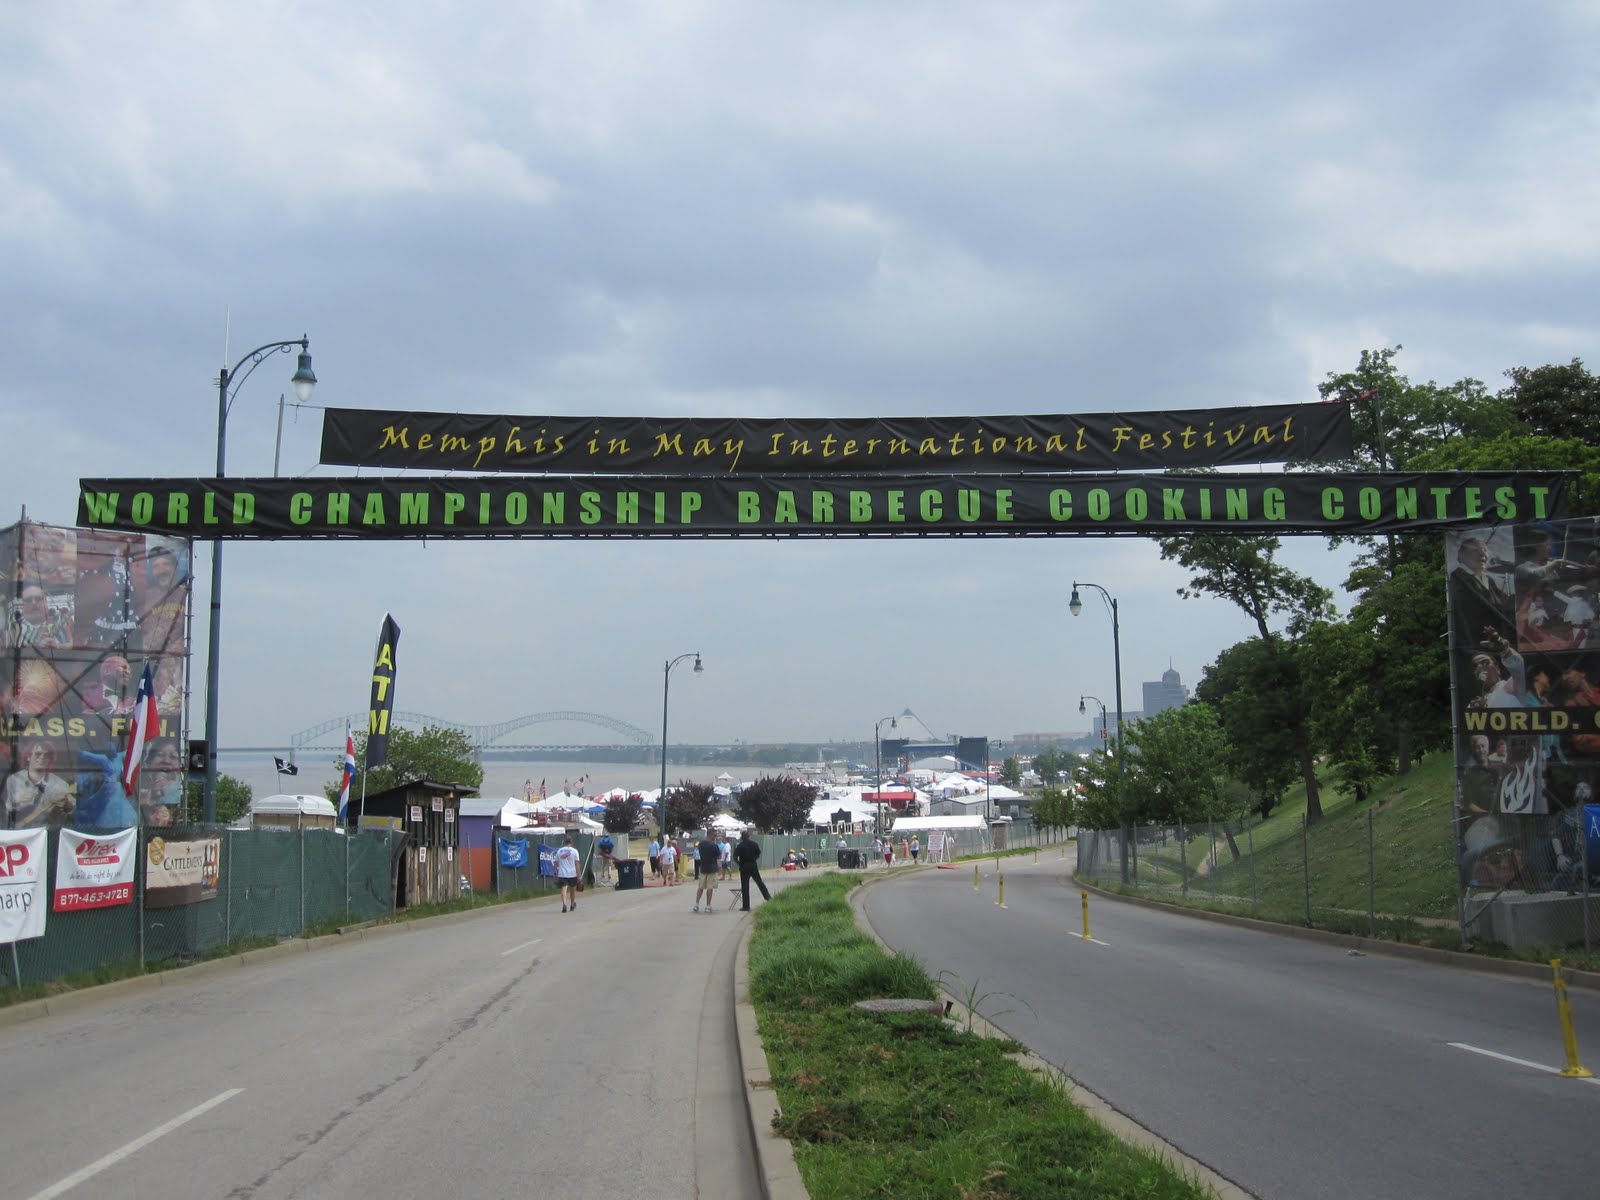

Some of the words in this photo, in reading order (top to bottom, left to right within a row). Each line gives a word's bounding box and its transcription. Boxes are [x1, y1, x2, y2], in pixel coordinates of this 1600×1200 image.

[379, 424, 566, 469] Memphis
[587, 429, 631, 454] in
[653, 432, 744, 472] May
[768, 426, 1088, 458] International
[1111, 416, 1297, 453] Festival
[85, 491, 256, 525] WORLD
[289, 490, 703, 526] CHAMPIONSHIP
[737, 488, 1014, 525] BARBECUE
[1049, 487, 1287, 522] COOKING
[1321, 486, 1550, 521] CONTEST
[367, 643, 394, 736] ATM
[0, 717, 97, 737] LASS.
[1464, 710, 1581, 731] WORLD.
